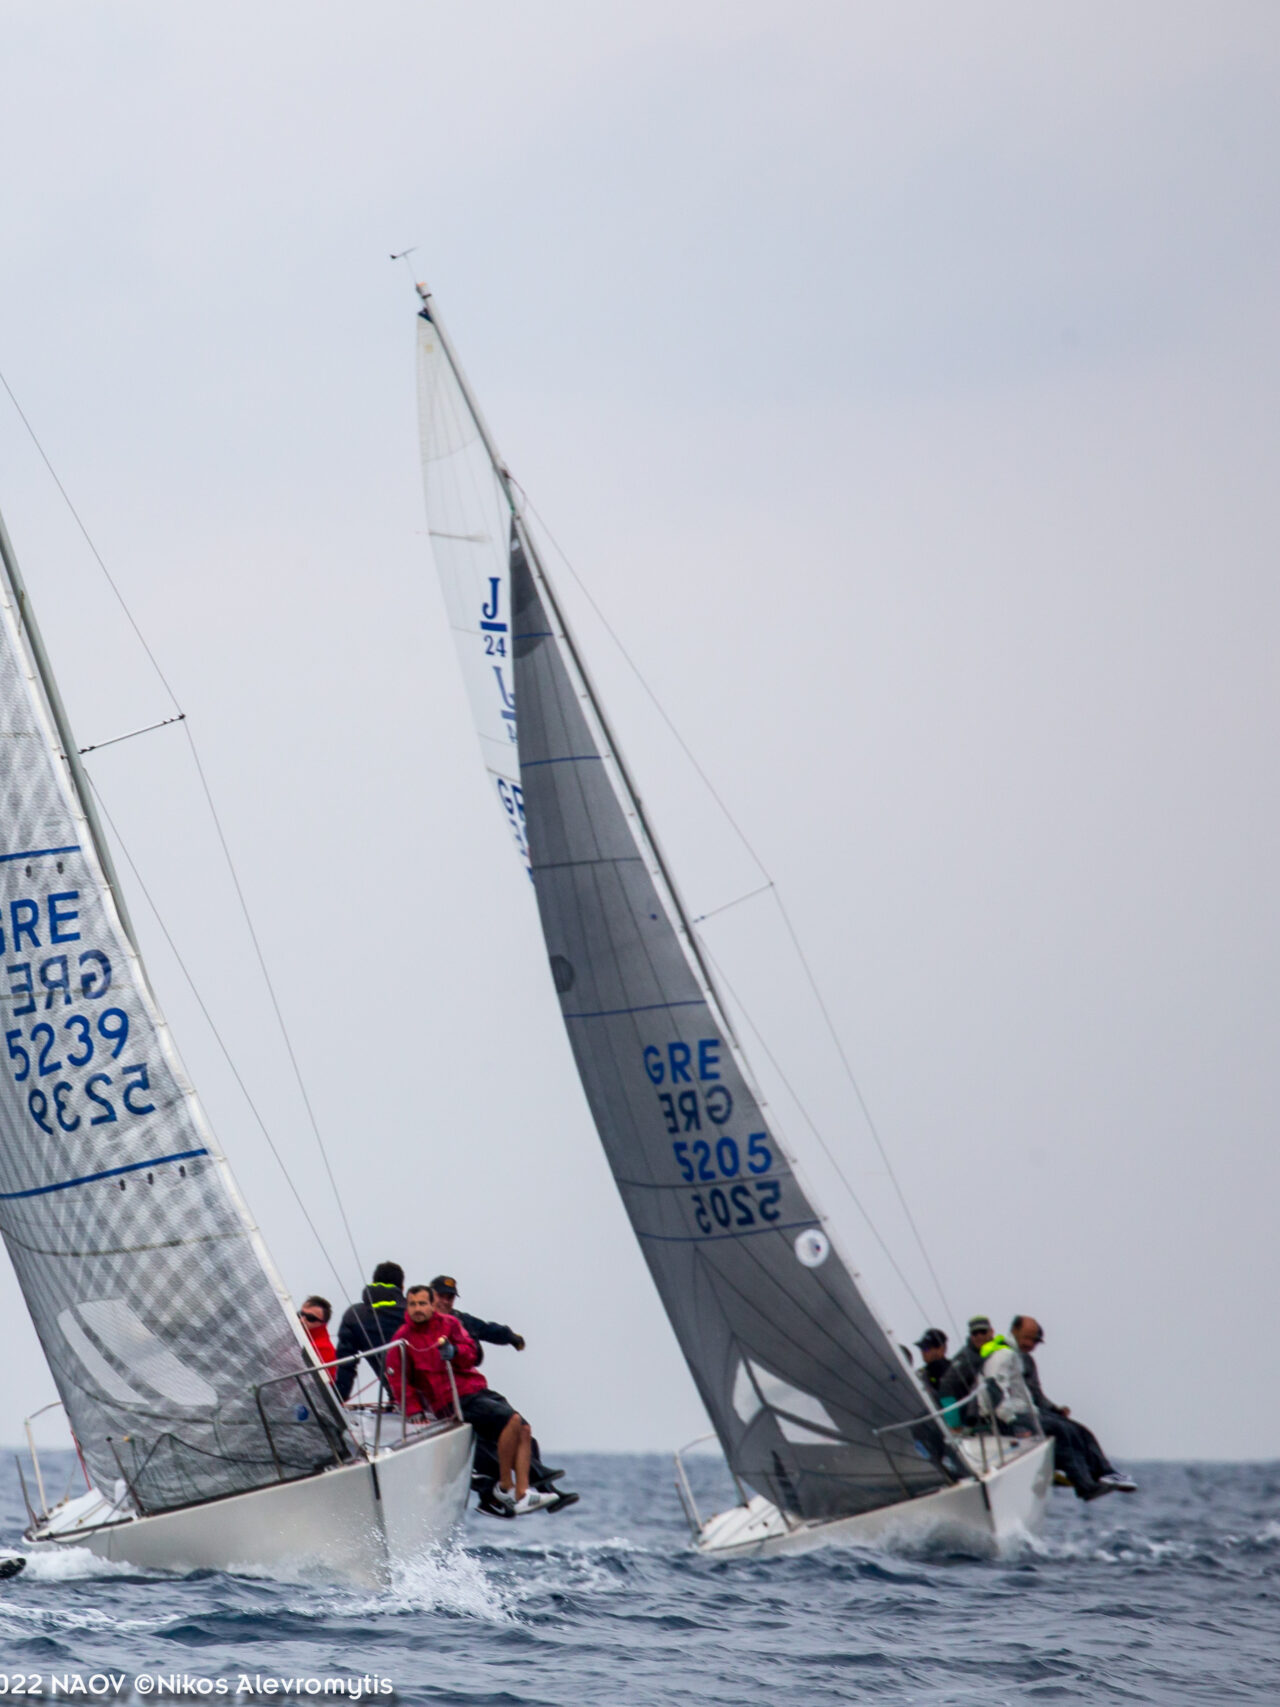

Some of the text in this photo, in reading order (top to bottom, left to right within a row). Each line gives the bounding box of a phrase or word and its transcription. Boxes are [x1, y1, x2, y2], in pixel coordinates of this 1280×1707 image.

[482, 577, 502, 620] J
[483, 635, 507, 658] 24
[5, 1007, 130, 1082] 5239
[642, 1039, 721, 1085] GRE
[672, 1132, 773, 1182] 5205
